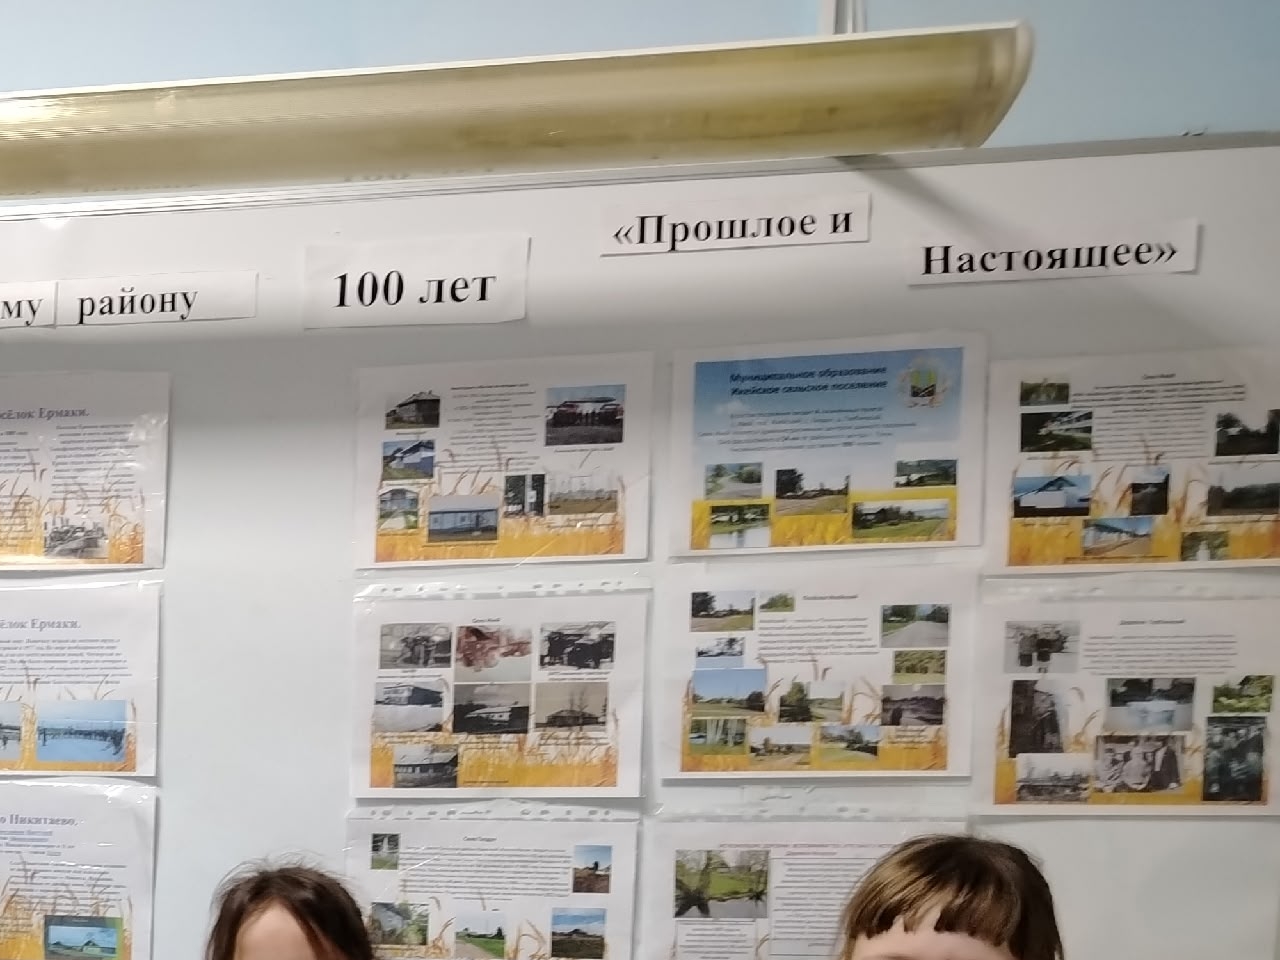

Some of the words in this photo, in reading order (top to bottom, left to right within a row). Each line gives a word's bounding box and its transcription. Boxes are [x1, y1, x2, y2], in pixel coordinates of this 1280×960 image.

[612, 212, 816, 250] «Прошлое
[829, 211, 852, 235] и
[922, 240, 1178, 276] Настоящее»
[77, 287, 198, 326] району
[333, 270, 403, 308] 100
[419, 273, 496, 304] лет
